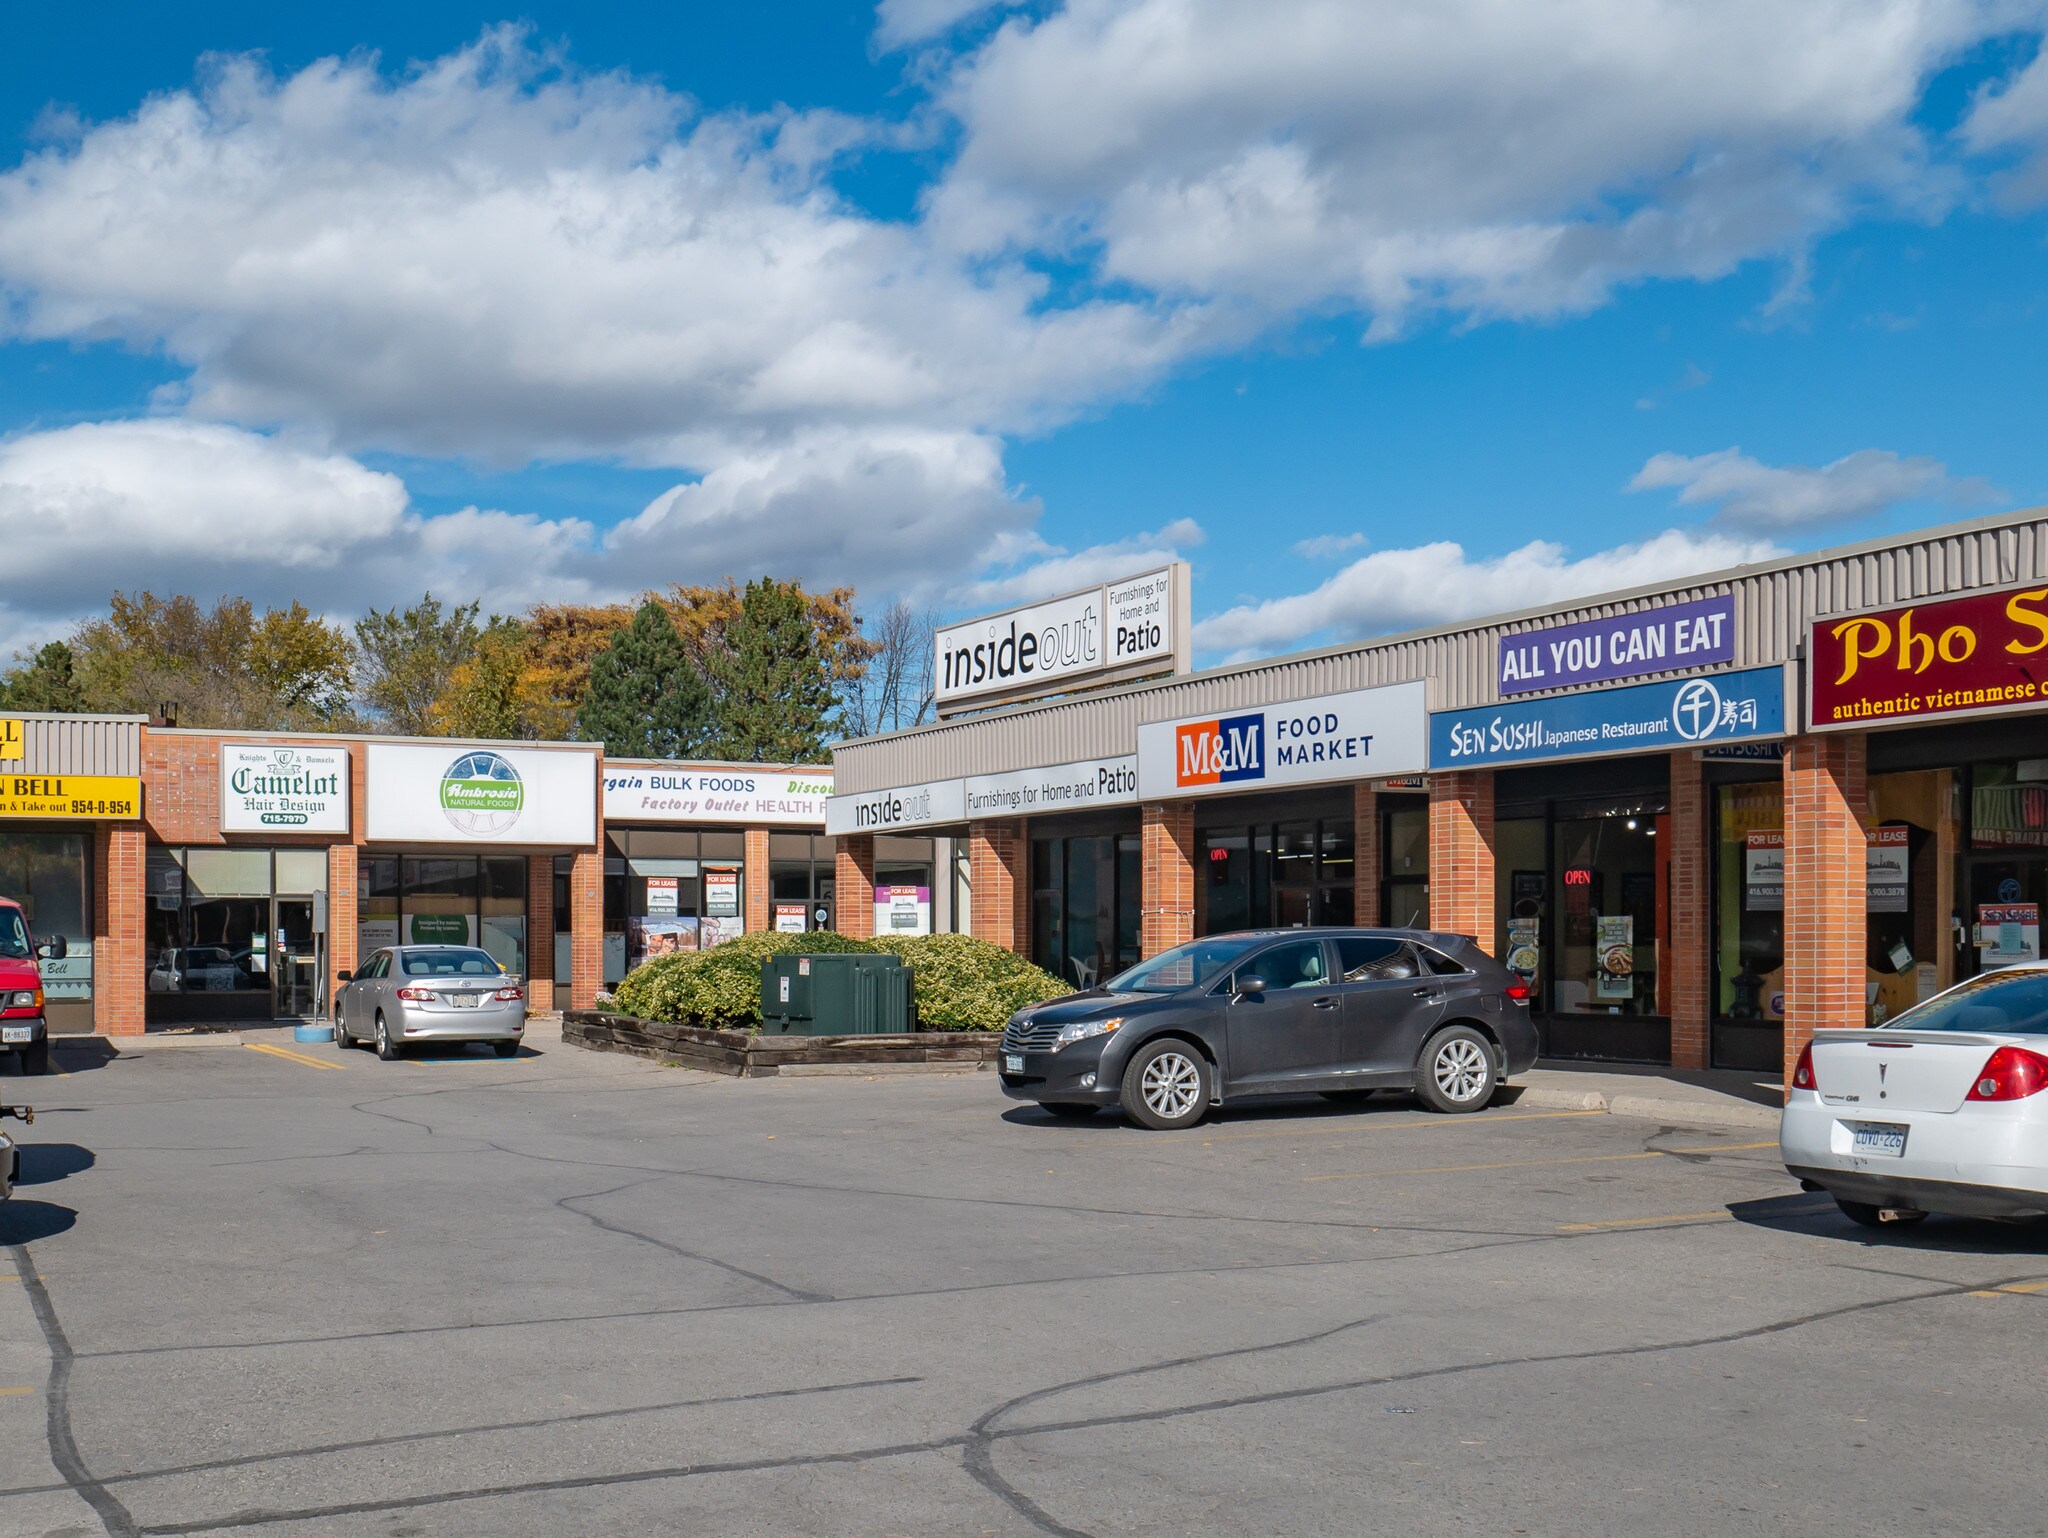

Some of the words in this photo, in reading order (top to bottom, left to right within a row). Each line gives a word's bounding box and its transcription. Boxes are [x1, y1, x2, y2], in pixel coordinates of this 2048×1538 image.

[1110, 582, 1154, 605] Furnishings
[1156, 578, 1168, 592] for
[1119, 605, 1143, 621] Home
[1145, 599, 1160, 614] and
[1117, 620, 1161, 656] Patio
[1502, 646, 1544, 682] ALL
[1550, 635, 1602, 674] YOU
[1609, 624, 1666, 665] CAN
[1674, 612, 1727, 655] EAT
[1831, 608, 1977, 685] Pho
[1833, 693, 1921, 719] authentic
[1925, 681, 2036, 709] vietnamese
[1277, 713, 1339, 740] FOOD
[1544, 727, 1599, 750] Japanese
[1602, 717, 1669, 739] Restaurant
[239, 753, 267, 762] Knights
[306, 755, 335, 764] Damsels
[1181, 725, 1260, 777] M&M
[1277, 735, 1374, 766] MARKET
[14, 779, 69, 797] BELL
[231, 767, 338, 796] Camelot
[650, 776, 692, 790] BULK
[699, 778, 755, 792] FOODS
[787, 780, 834, 795] Discou
[968, 789, 1021, 810] Furnishings
[1023, 786, 1039, 803] for
[1041, 783, 1072, 801] Home
[1074, 777, 1095, 798] and
[1098, 764, 1136, 795] Patio
[446, 783, 519, 799] Ambrosia
[9, 802, 18, 811] &
[21, 801, 46, 811] Take
[49, 803, 67, 812] out
[71, 800, 132, 814] 954-0-954
[243, 797, 275, 811] Hair
[279, 798, 326, 814] Design
[450, 798, 486, 806] NATURAL
[640, 796, 698, 814] Factory
[704, 798, 750, 812] Outlet
[756, 800, 812, 813] HEALTH
[263, 814, 306, 823] 715-7979
[1747, 835, 1765, 844] FOR
[1879, 831, 1907, 842] LEASE
[1210, 848, 1228, 860] OPEN
[1565, 870, 1591, 885] OPEN
[47, 962, 69, 974] Bell
